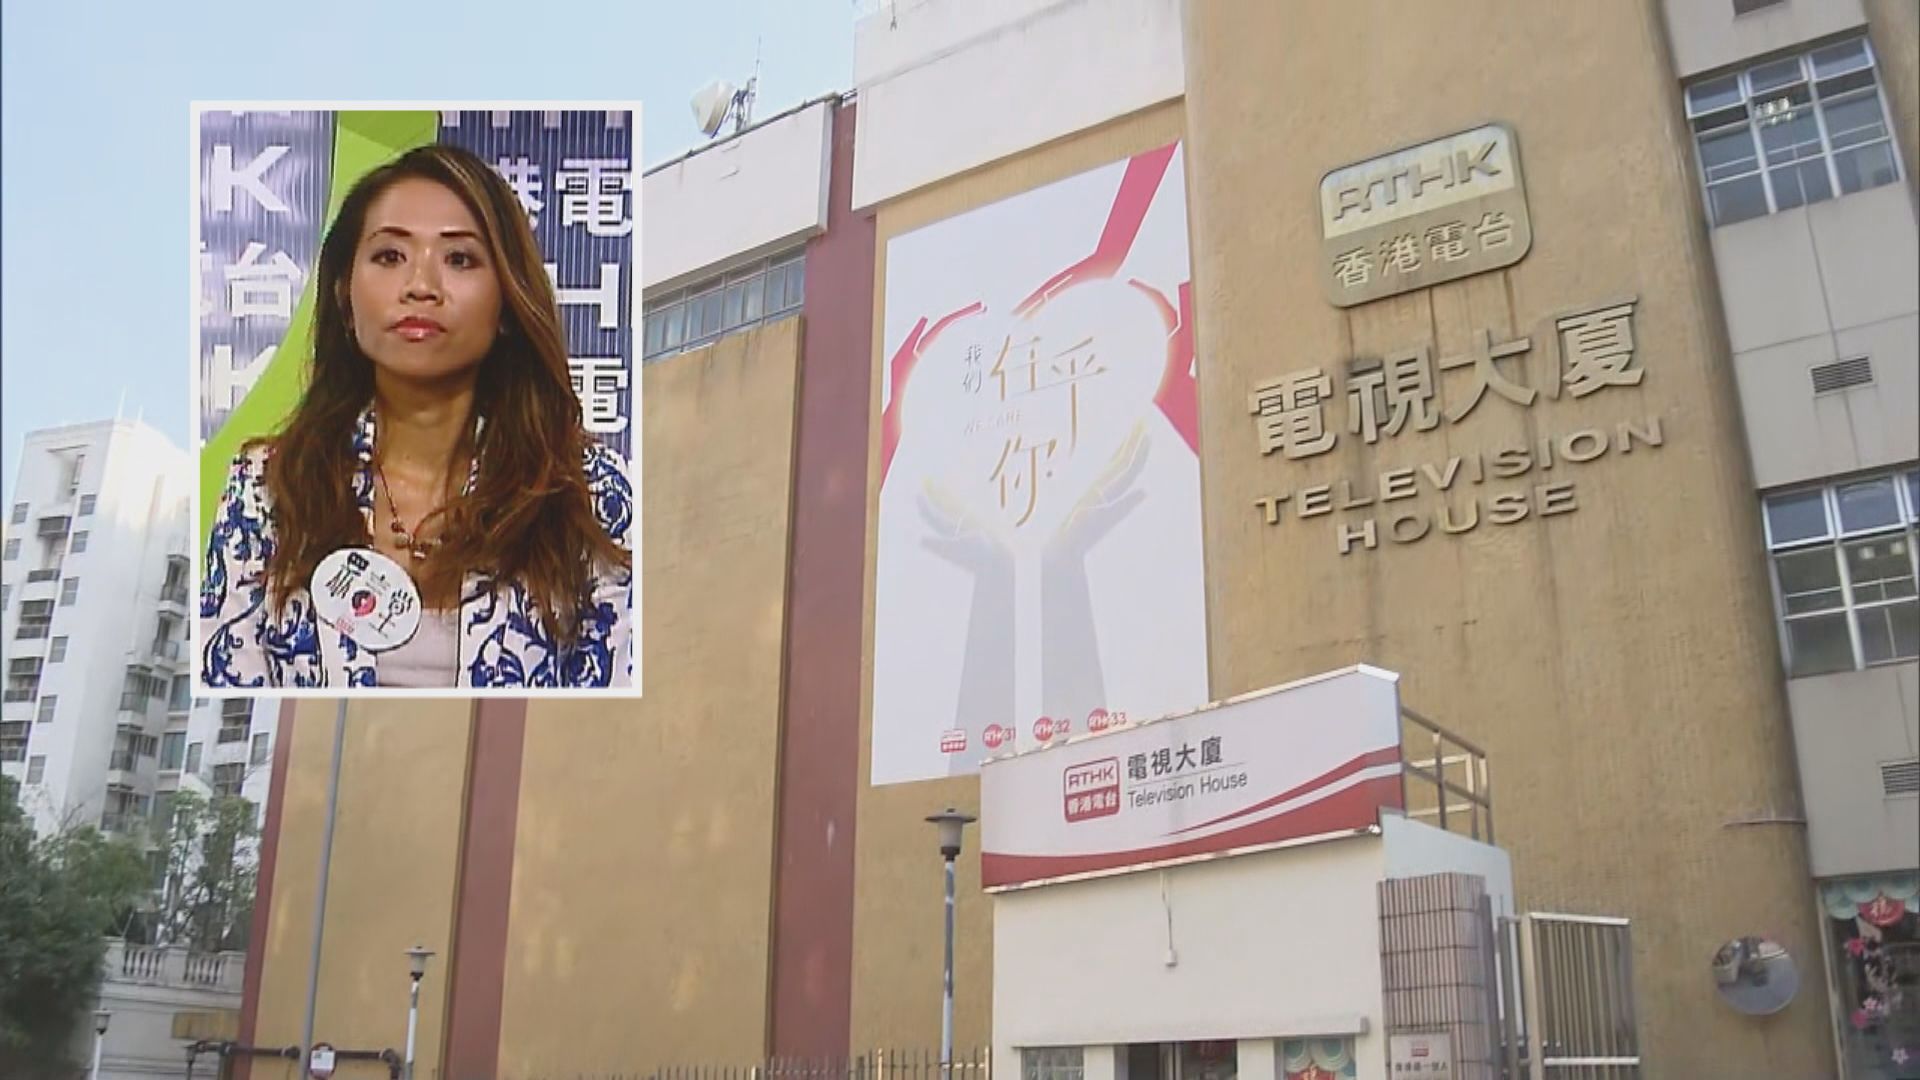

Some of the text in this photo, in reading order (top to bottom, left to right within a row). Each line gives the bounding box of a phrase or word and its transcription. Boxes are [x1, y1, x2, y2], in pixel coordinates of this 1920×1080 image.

[211, 145, 292, 212] K
[1333, 139, 1501, 221] RTHK
[1332, 211, 1514, 288] 香港電台
[1256, 415, 1664, 525] TELEVISION
[1337, 480, 1578, 554] HOUSE
[1068, 765, 1115, 790] RTHK
[1127, 771, 1248, 809] Television House
